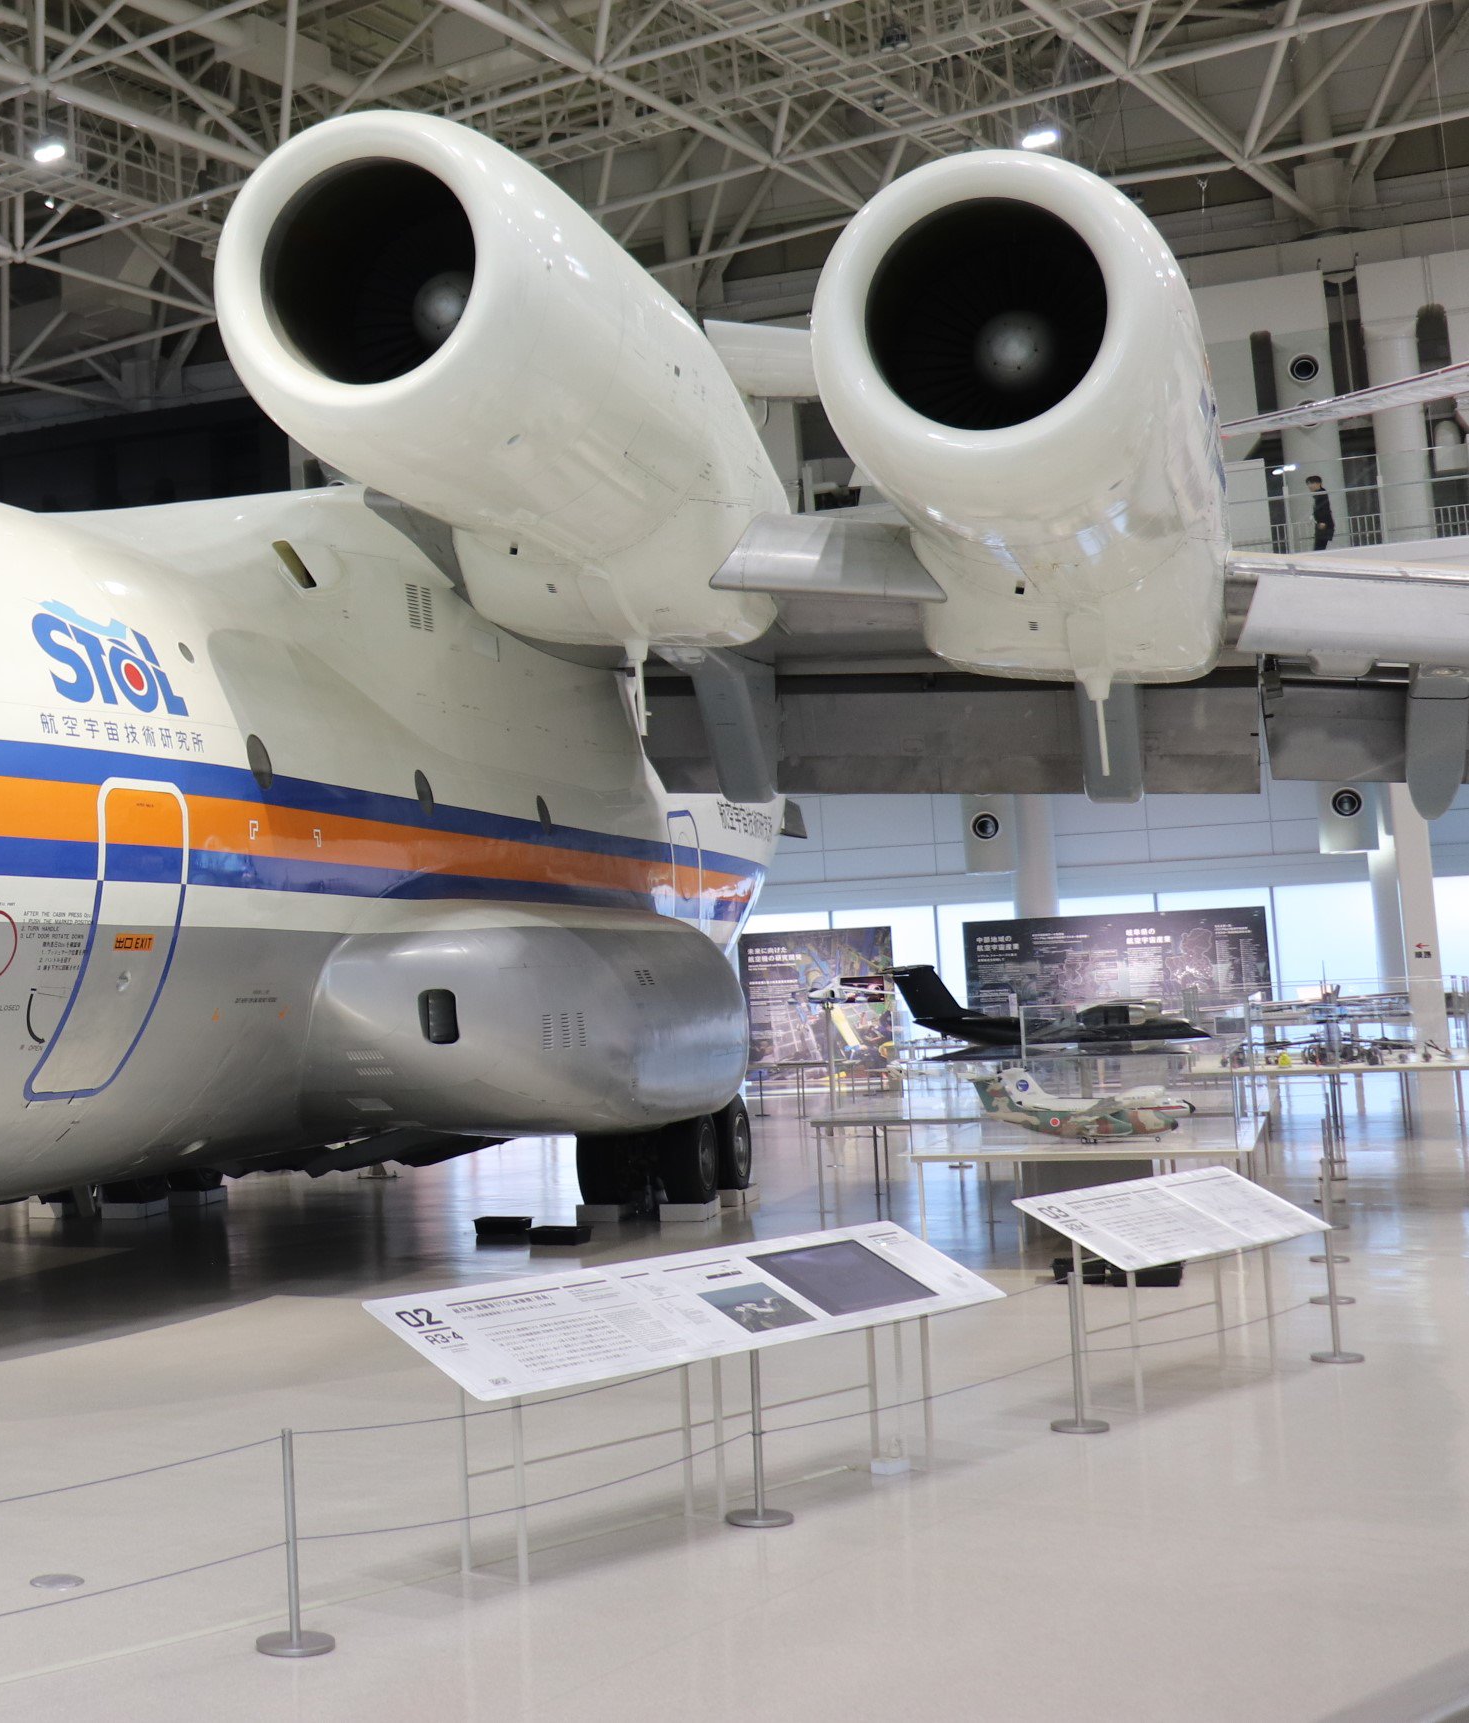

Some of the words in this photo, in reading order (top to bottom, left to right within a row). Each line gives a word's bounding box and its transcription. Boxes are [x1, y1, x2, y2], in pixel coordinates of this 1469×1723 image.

[32, 612, 189, 717] STOL
[40, 711, 205, 754] 航空宇宙技術研究所
[115, 937, 133, 949] 出口
[134, 937, 153, 949] EXIT
[747, 946, 788, 955] 未来に向けた
[395, 1307, 444, 1328] 02
